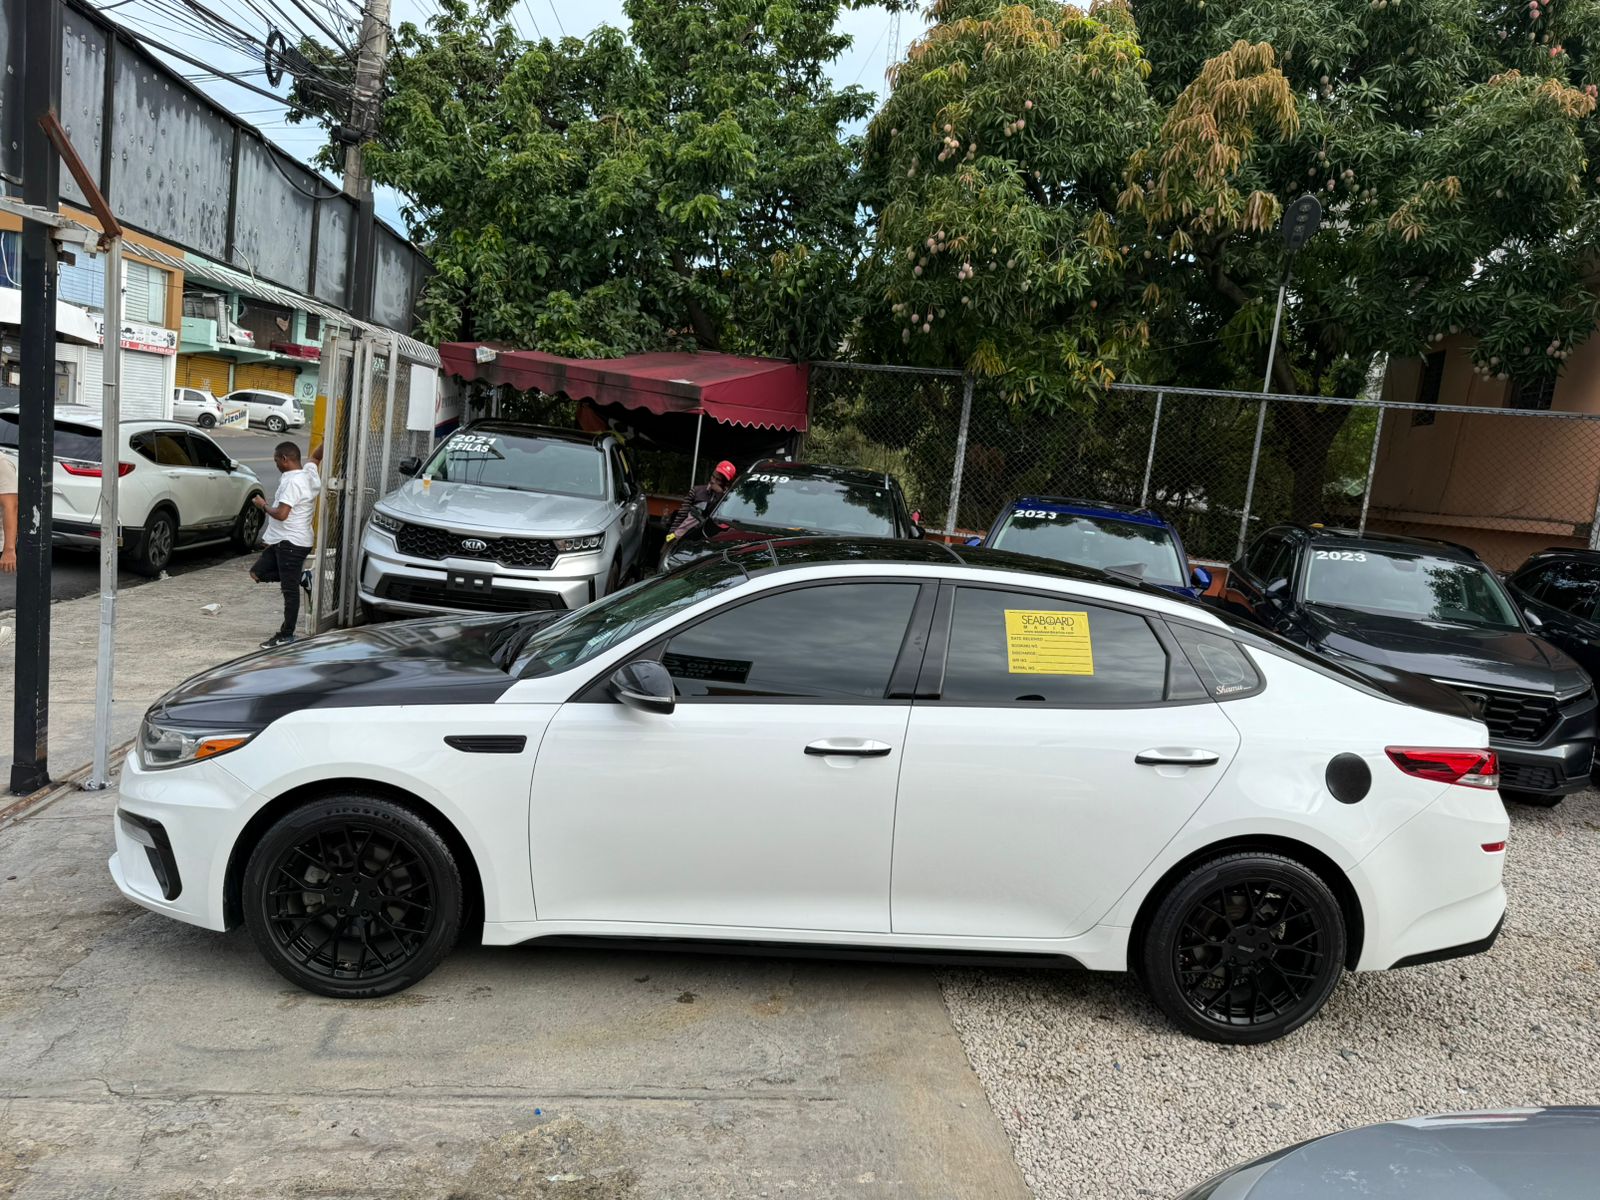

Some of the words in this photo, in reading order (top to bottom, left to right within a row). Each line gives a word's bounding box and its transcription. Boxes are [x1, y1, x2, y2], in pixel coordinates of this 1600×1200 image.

[452, 434, 497, 444] 2021
[446, 442, 490, 452] 3-FILAS
[747, 474, 790, 483] 2019
[1013, 509, 1057, 519] 2023
[464, 540, 483, 550] KIA
[1315, 550, 1367, 562] 2023
[1021, 615, 1075, 626] SEABOARD
